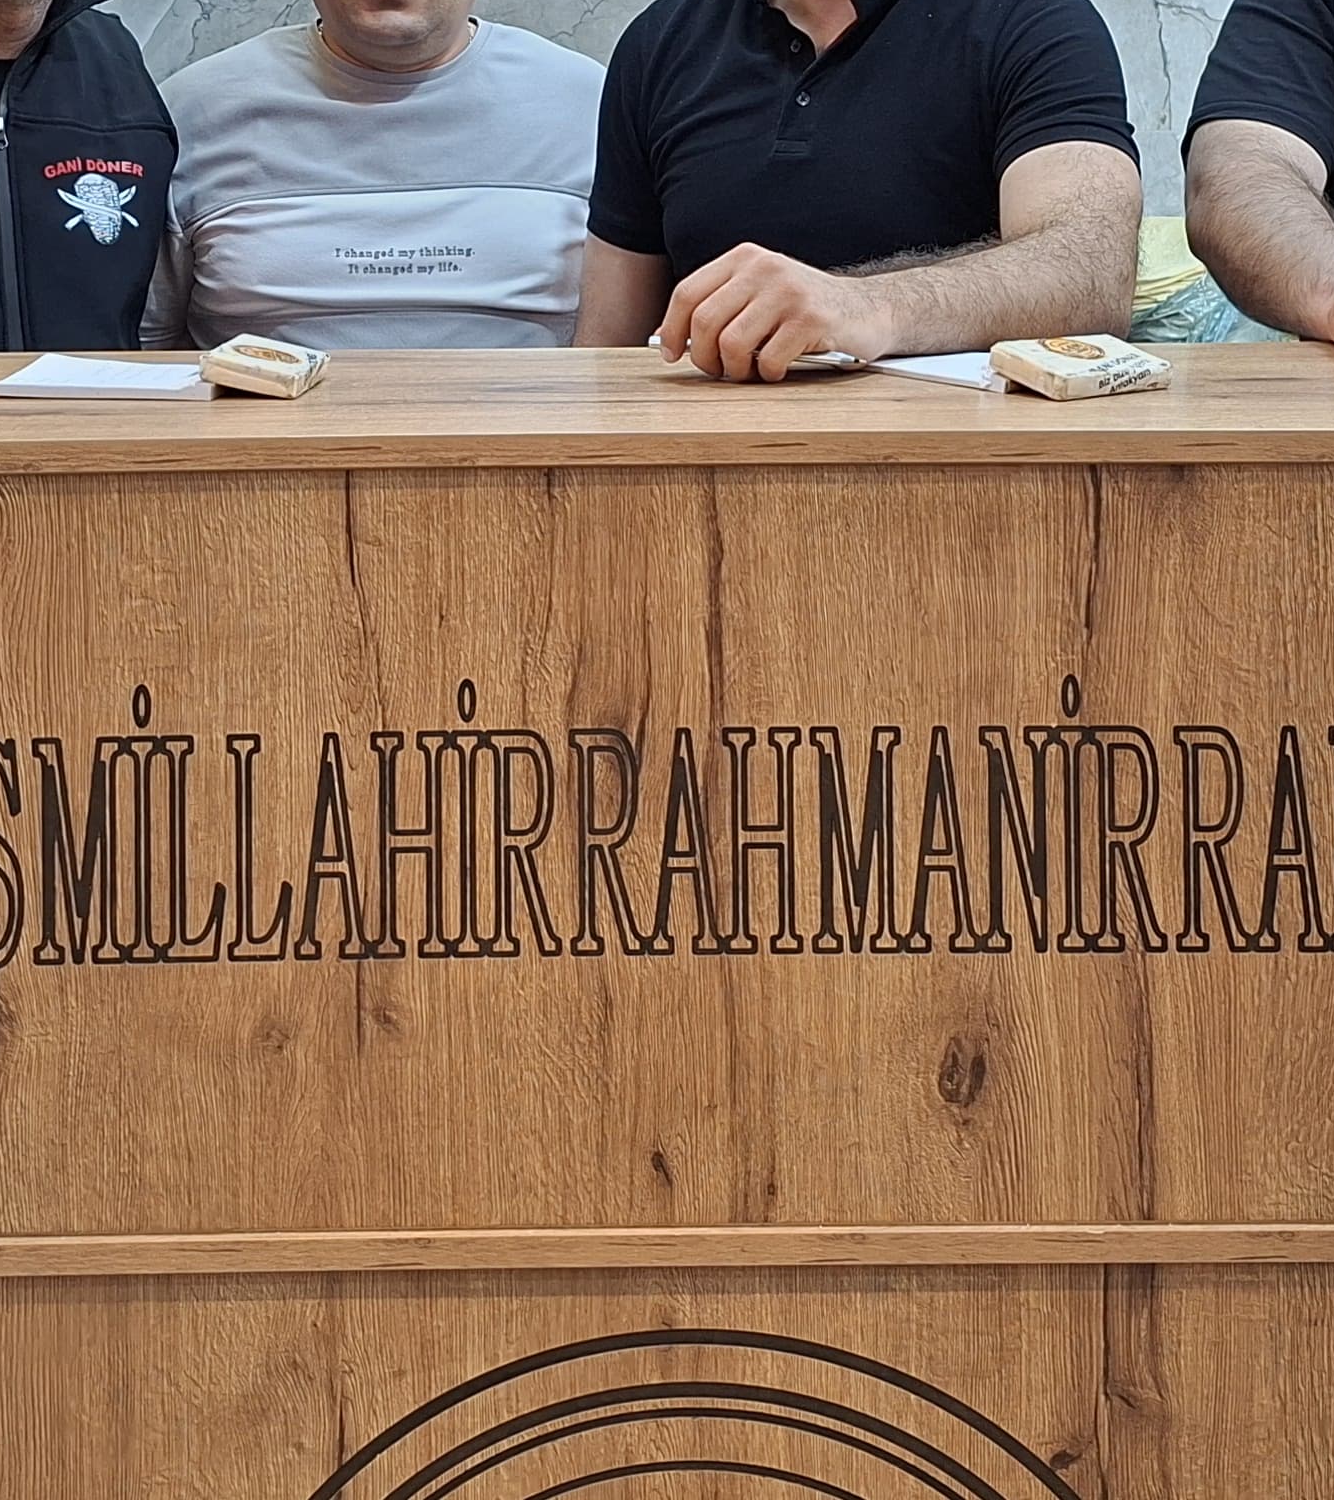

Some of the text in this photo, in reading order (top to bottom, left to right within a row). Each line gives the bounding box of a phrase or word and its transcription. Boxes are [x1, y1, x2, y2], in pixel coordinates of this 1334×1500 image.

[43, 156, 145, 179] GANİ DÖNER
[334, 246, 476, 259] I changed my thinking.
[348, 263, 359, 274] It
[363, 263, 413, 275] changed
[416, 264, 435, 275] my
